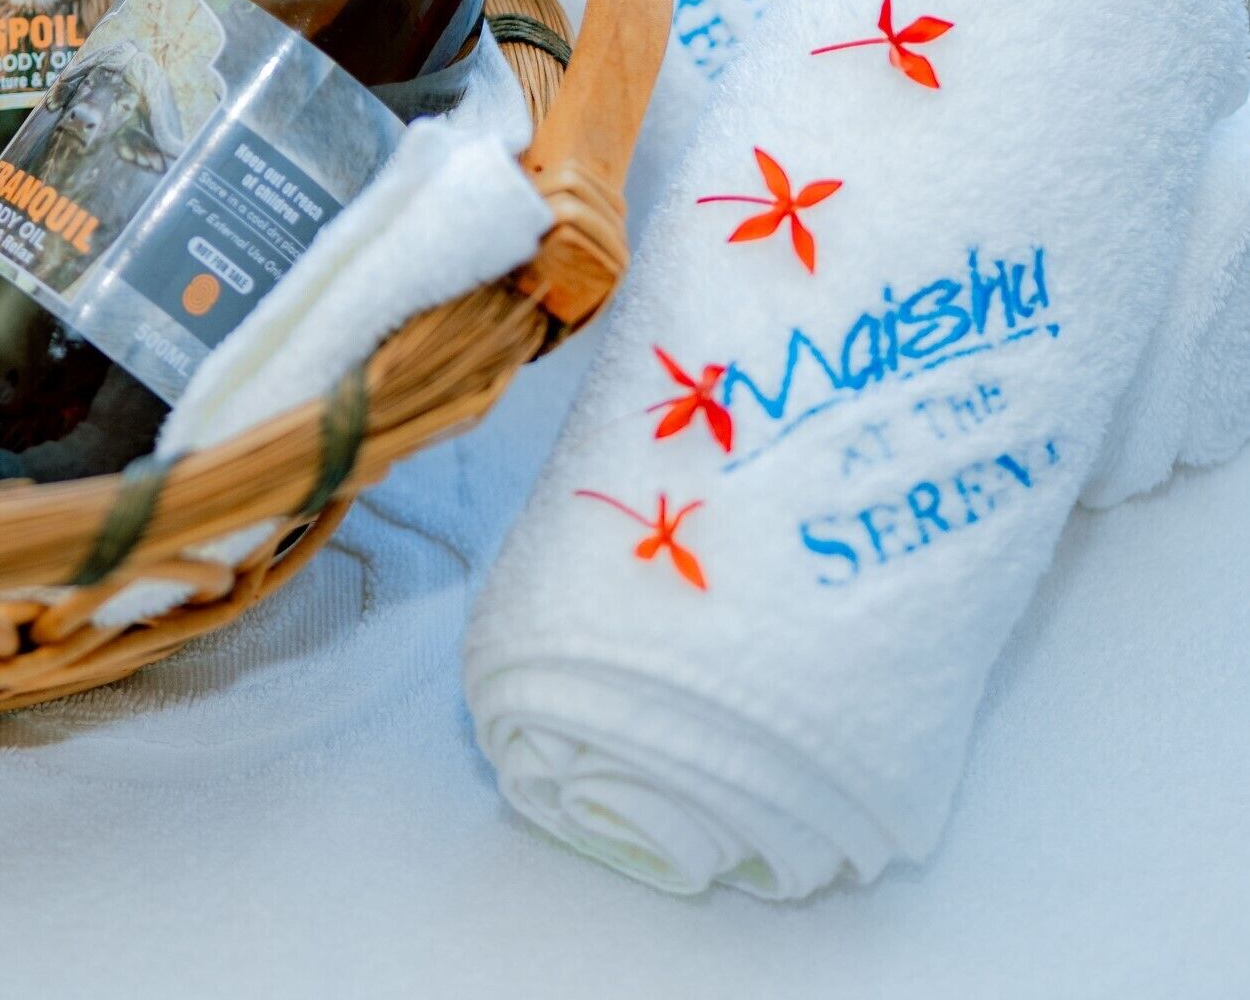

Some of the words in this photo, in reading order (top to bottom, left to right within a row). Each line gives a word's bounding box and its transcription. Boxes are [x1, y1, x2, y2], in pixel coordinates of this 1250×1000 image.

[51, 50, 76, 69] OI
[198, 171, 227, 197] Store
[247, 211, 269, 231] cool
[266, 227, 284, 246] dry
[234, 143, 266, 173] Keep
[263, 167, 286, 188] out
[281, 181, 298, 198] of
[293, 192, 323, 222] reach
[241, 173, 259, 189] of
[254, 184, 300, 225] children
[1, 235, 35, 264] Relax
[18, 221, 46, 251] OIL
[185, 198, 207, 216] For
[206, 212, 250, 249] External
[247, 245, 266, 265] Use
